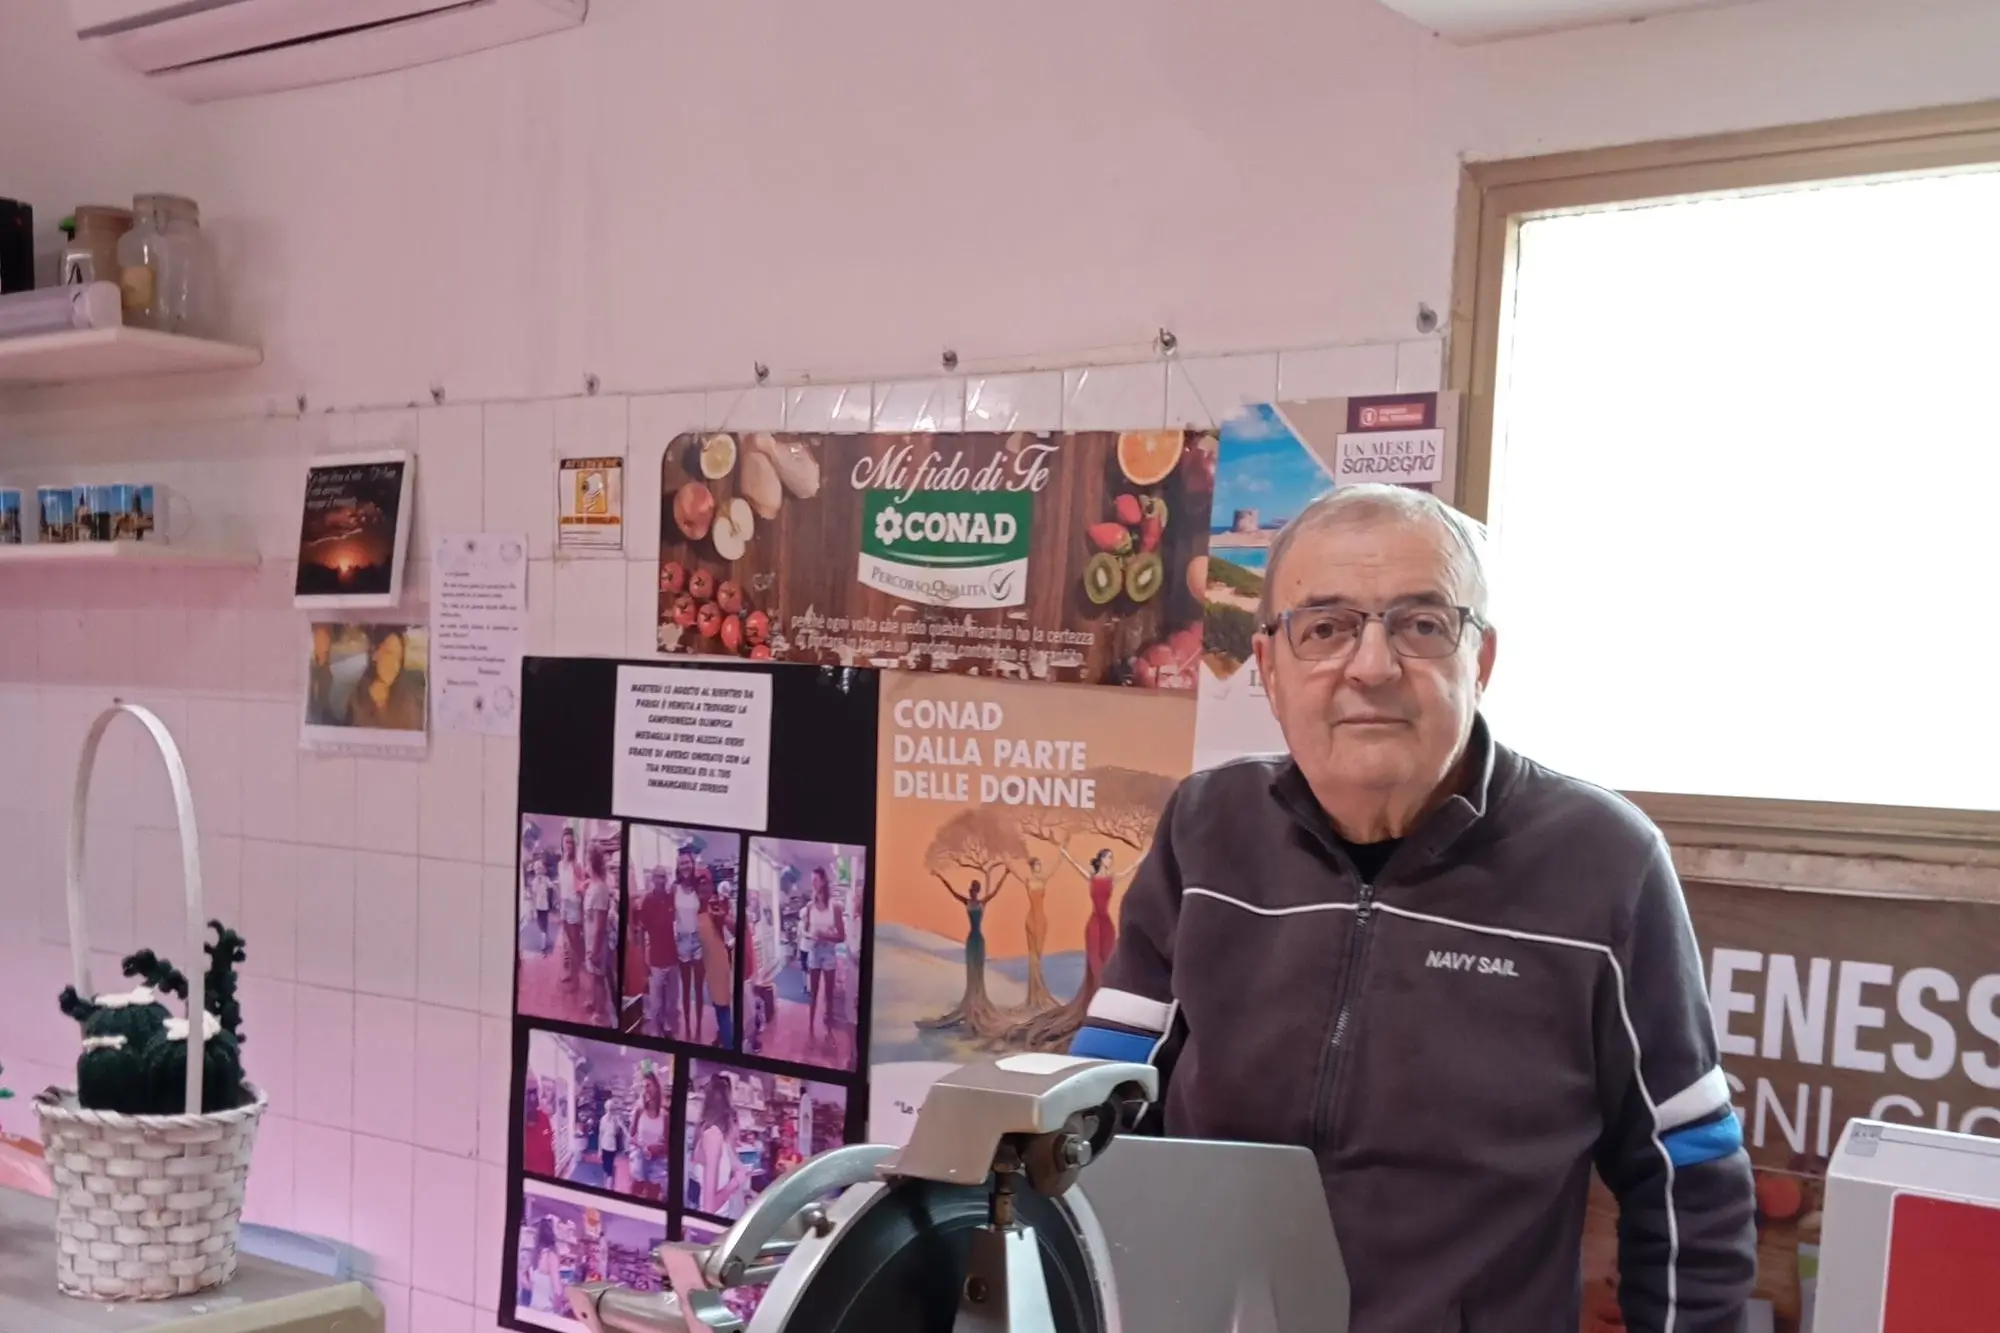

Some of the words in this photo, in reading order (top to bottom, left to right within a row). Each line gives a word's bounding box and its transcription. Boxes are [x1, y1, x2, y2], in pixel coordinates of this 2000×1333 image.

[1343, 443, 1364, 457] UN
[1372, 440, 1414, 456] MESE
[1420, 440, 1436, 454] IN
[851, 444, 914, 490] Mi
[894, 451, 970, 504] fido
[971, 451, 1008, 494] di
[1005, 443, 1060, 492] Te
[904, 511, 1017, 545] CONAD
[1015, 625, 1030, 642] ho
[1033, 625, 1045, 643] la
[1047, 628, 1095, 646] certezza
[893, 699, 1004, 731] CONAD
[894, 734, 983, 767] DALLA
[993, 738, 1087, 772] PARTE
[894, 770, 969, 801] DELLE
[980, 773, 1097, 809] DONNE
[1425, 950, 1477, 972] NAVY
